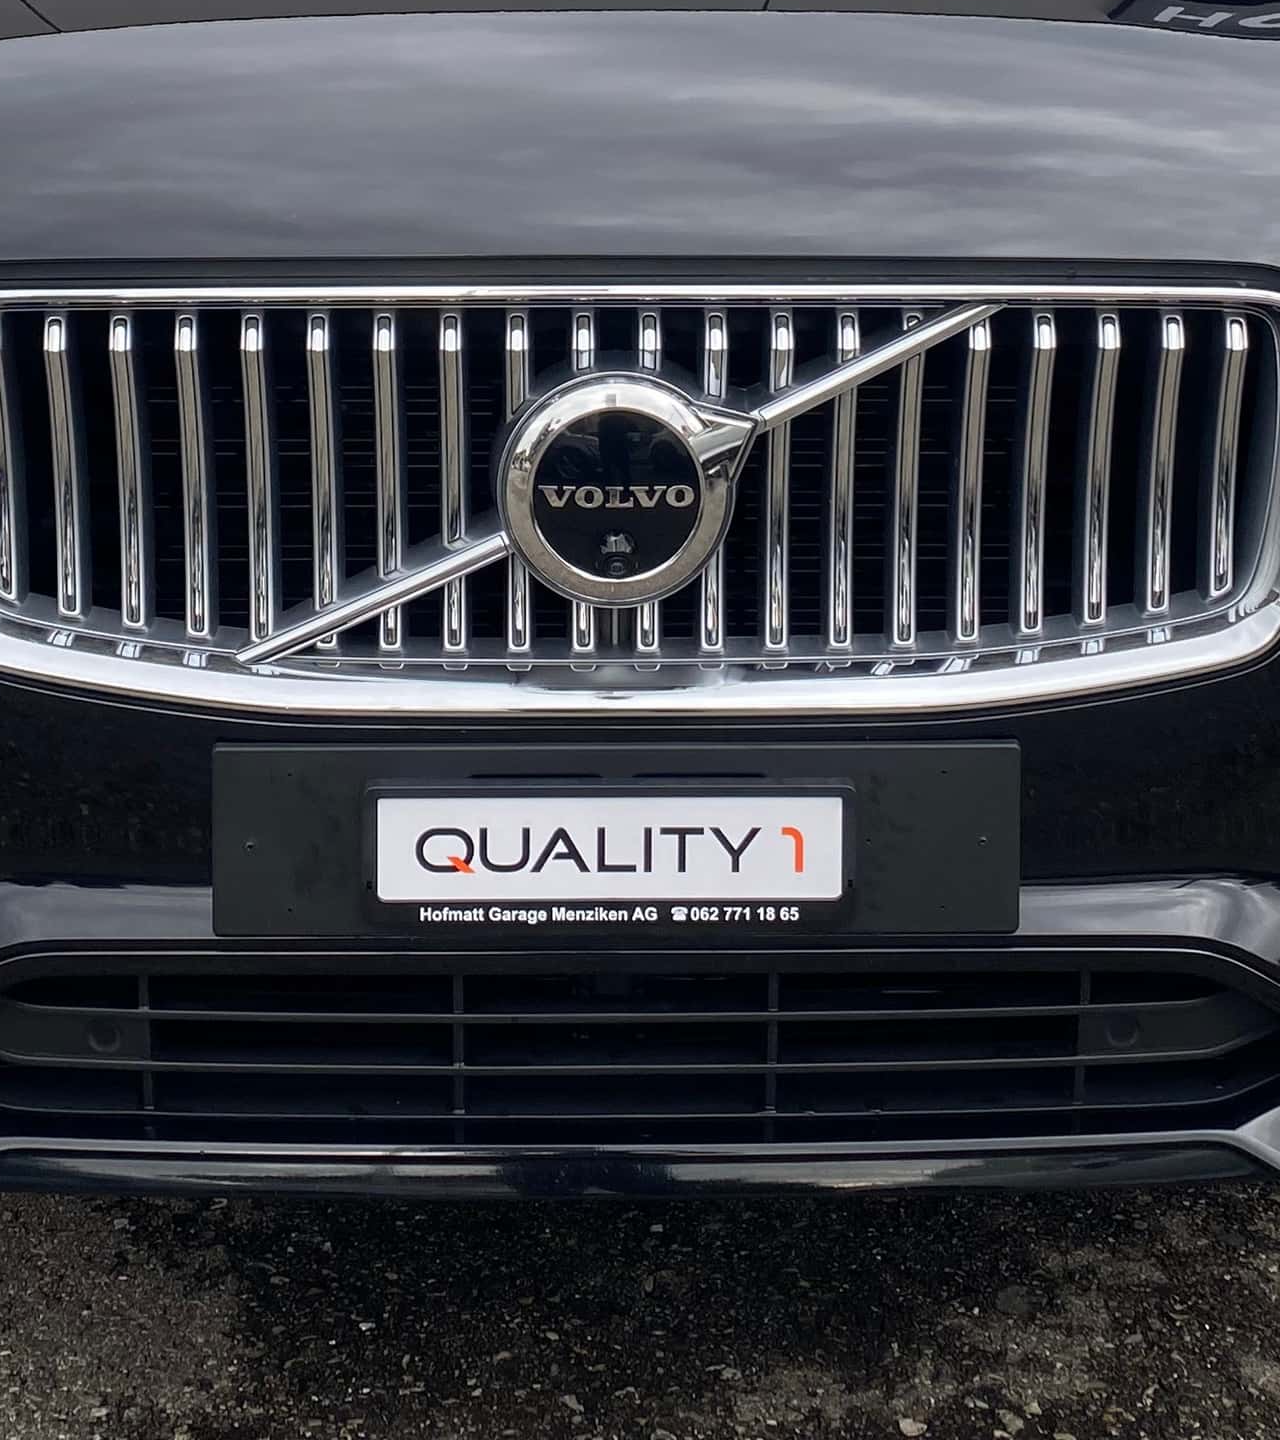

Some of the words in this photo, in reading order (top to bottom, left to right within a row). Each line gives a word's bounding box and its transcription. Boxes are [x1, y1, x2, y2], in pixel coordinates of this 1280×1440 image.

[538, 485, 695, 509] VOLVO
[415, 826, 762, 874] QUALITY
[780, 826, 804, 873] 1
[419, 906, 485, 922] Hofmatt
[487, 906, 548, 925] Garage
[551, 906, 628, 922] Menziken
[631, 906, 659, 922] AG
[690, 906, 719, 922] 062
[723, 906, 751, 922] 771
[756, 906, 776, 922] 18
[779, 906, 800, 922] 65
